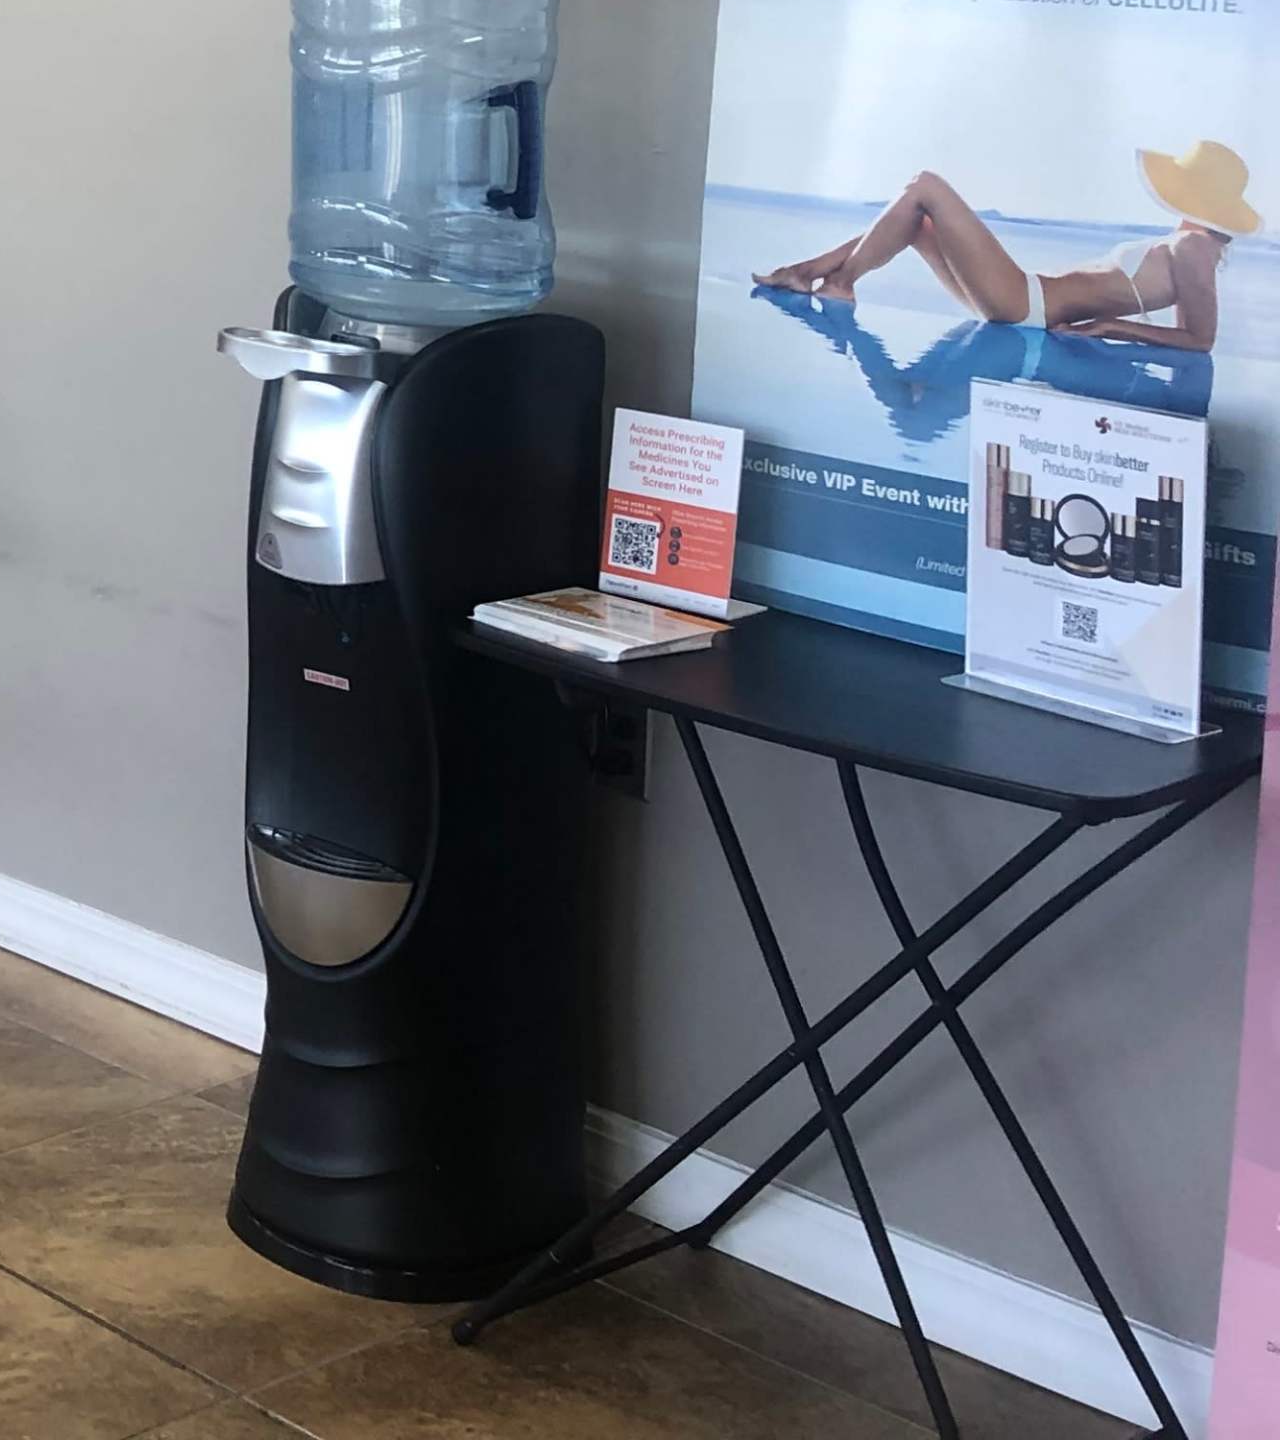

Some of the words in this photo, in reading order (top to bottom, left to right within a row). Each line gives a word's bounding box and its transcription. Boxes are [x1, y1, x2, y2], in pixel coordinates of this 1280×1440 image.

[629, 423, 665, 438] Access
[667, 429, 725, 450] Prescribing
[629, 435, 687, 455] Information
[690, 447, 705, 458] for
[706, 449, 723, 460] the
[638, 450, 689, 468] Medicines
[693, 460, 711, 472] You
[1019, 434, 1058, 455] Register
[1060, 442, 1071, 456] to
[1073, 444, 1092, 464] Buy
[1094, 449, 1150, 473] skinbetter
[629, 461, 647, 472] See
[649, 465, 704, 484] Advertised
[706, 477, 719, 487] on
[642, 476, 676, 491] Screen
[679, 484, 703, 497] Here
[743, 457, 818, 484] xclusive
[822, 470, 856, 492] VIP
[862, 479, 921, 506] Event
[1043, 459, 1086, 482] Products
[1089, 469, 1123, 488] Online!
